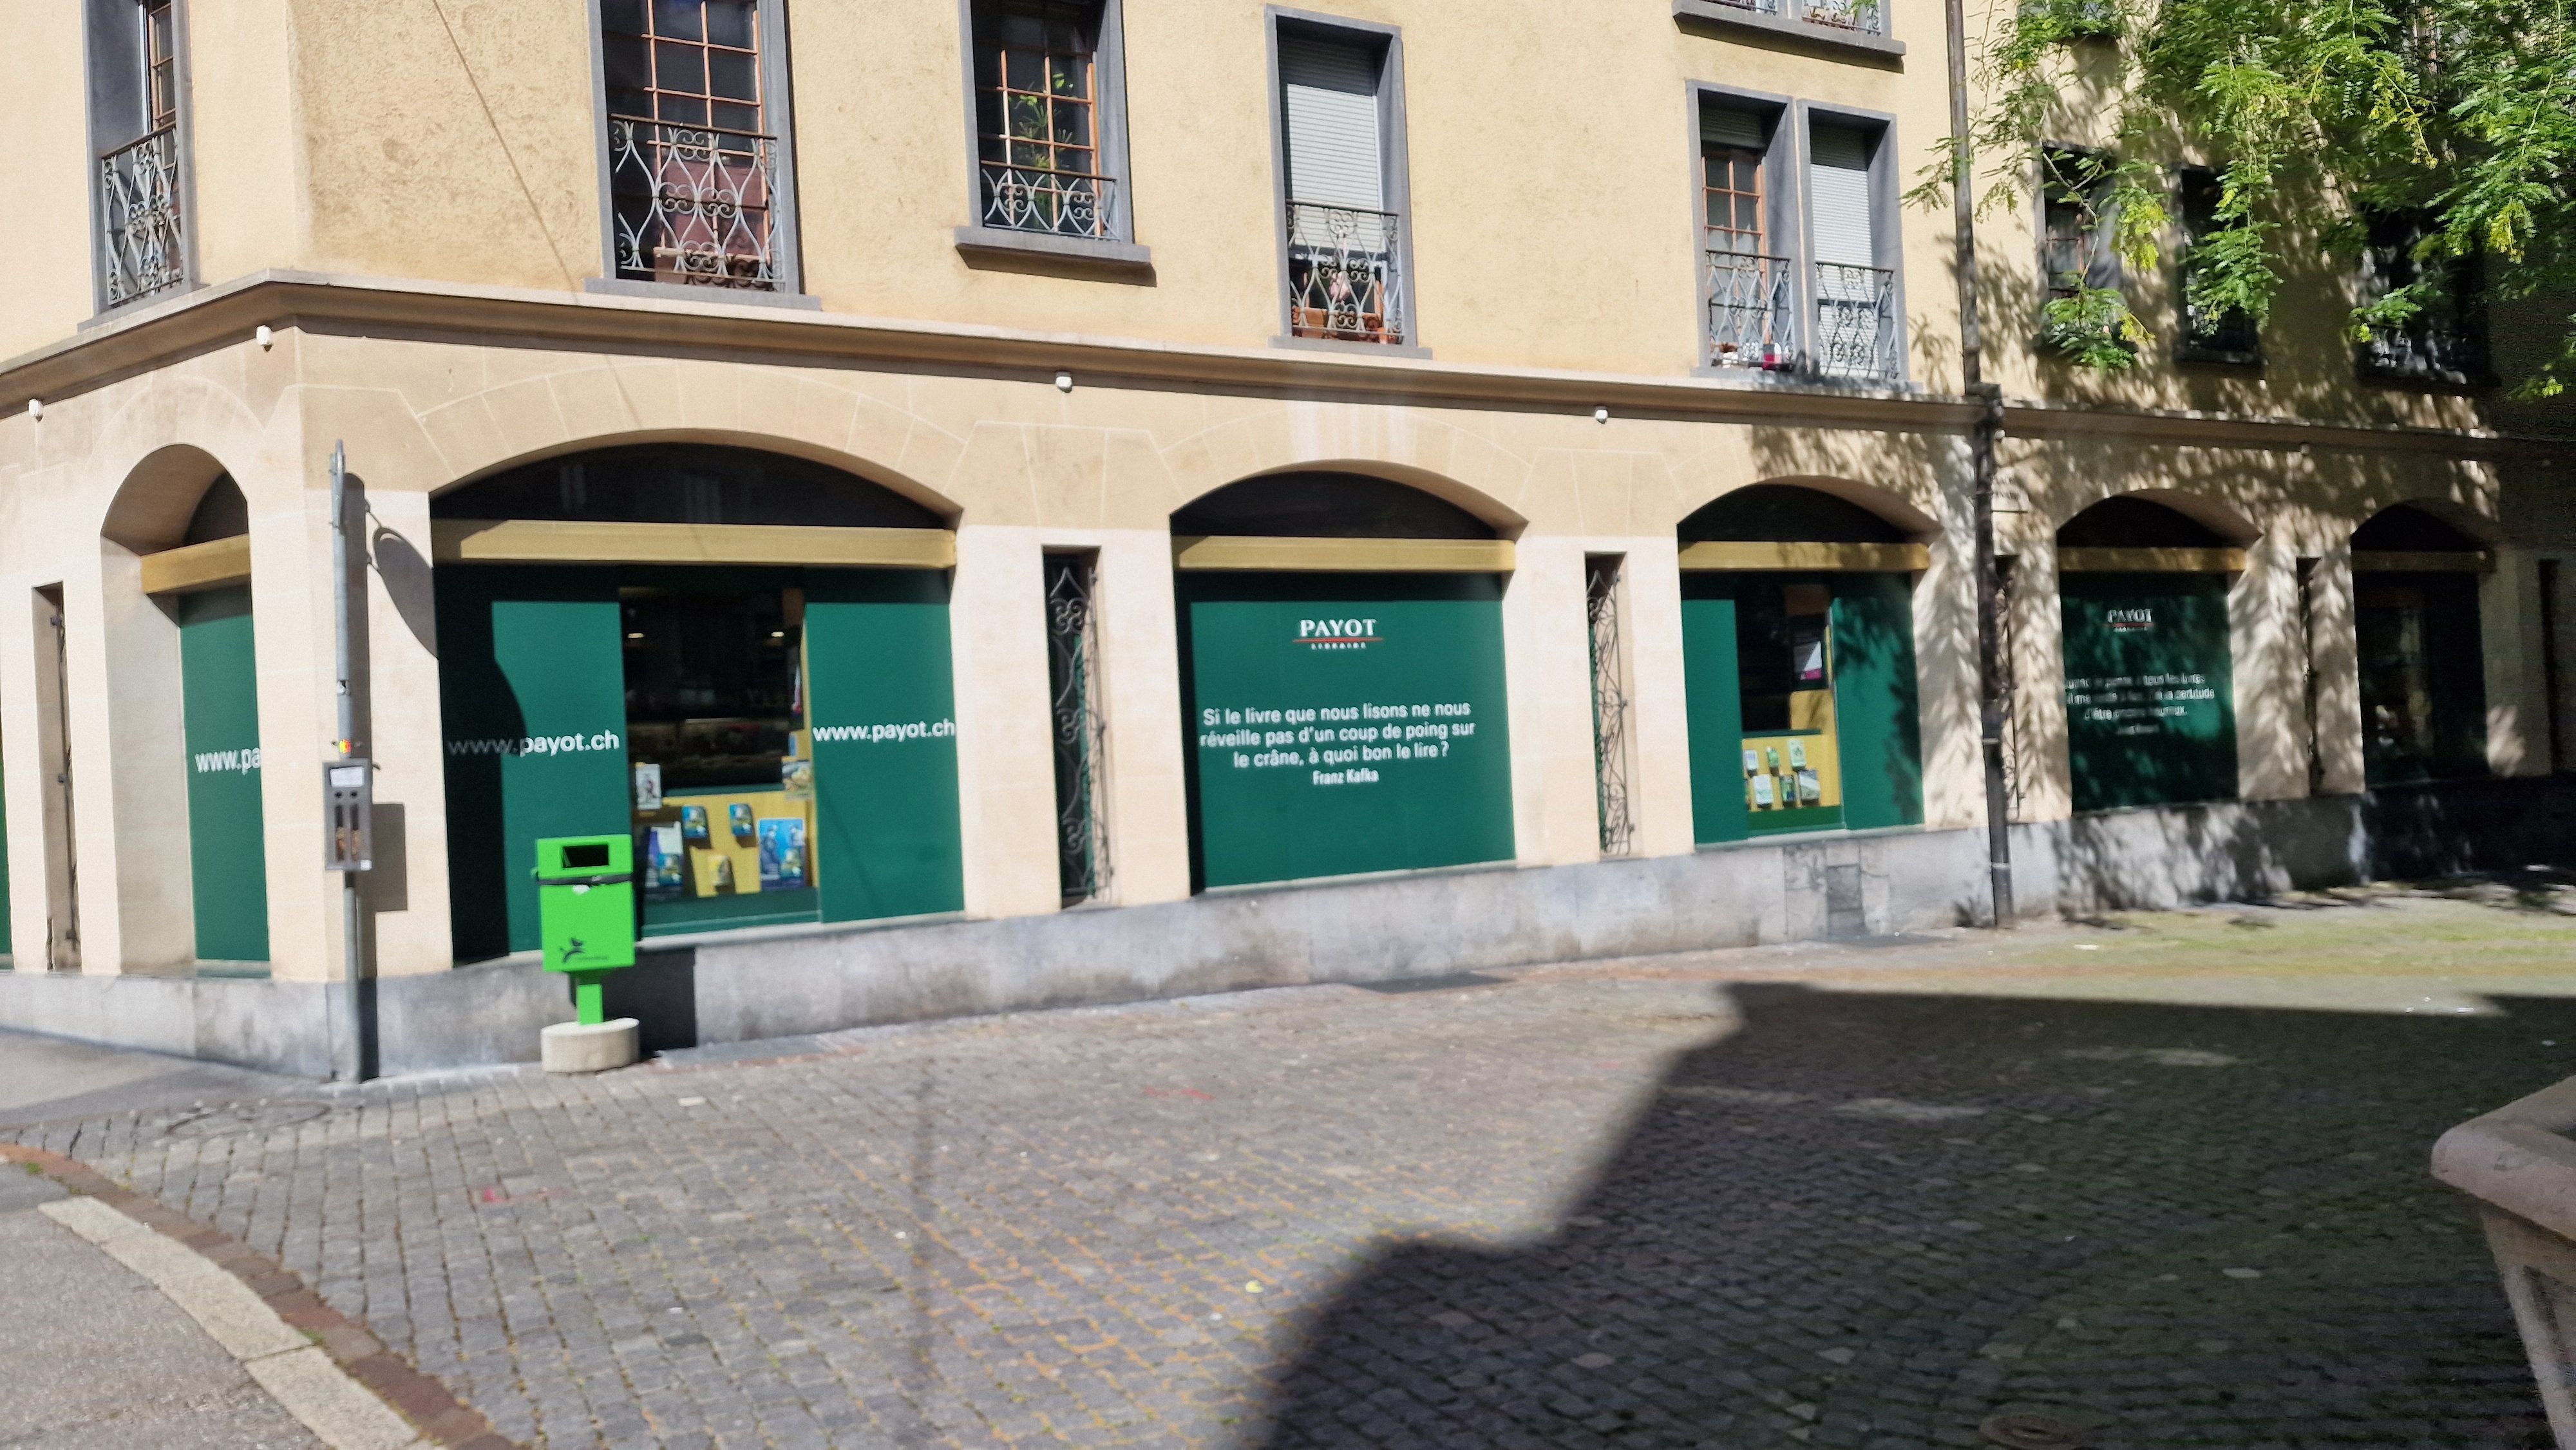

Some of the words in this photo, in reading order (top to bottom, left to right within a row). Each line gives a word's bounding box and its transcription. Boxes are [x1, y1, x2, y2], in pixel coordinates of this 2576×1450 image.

[2107, 608, 2152, 623] PAYOT
[1300, 619, 1377, 637] PAYOT
[1204, 709, 1220, 726] Si
[1226, 709, 1240, 724] le
[1245, 708, 1282, 723] livre
[1285, 709, 1316, 724] que
[1321, 707, 1359, 720] nous
[1363, 703, 1408, 719] lisons
[1412, 704, 1430, 717] ne
[1435, 703, 1470, 716] nous
[813, 718, 956, 742] www.payot.ch
[1200, 730, 1260, 747] réveille
[1265, 731, 1294, 747] pas
[1299, 726, 1334, 742] d'un
[1340, 727, 1378, 742] coup
[1383, 723, 1401, 739] de
[1406, 722, 1448, 740] poing
[1452, 723, 1475, 736] sur
[446, 729, 620, 757] www.payot.ch
[1234, 752, 1249, 767] le
[1254, 749, 1303, 767] crâne,
[1309, 748, 1319, 764] à
[1323, 746, 1358, 765] quoi
[1363, 746, 1392, 760] bon
[1397, 744, 1410, 758] le
[1313, 771, 1344, 785] Franz
[1347, 768, 1379, 783] Kafka
